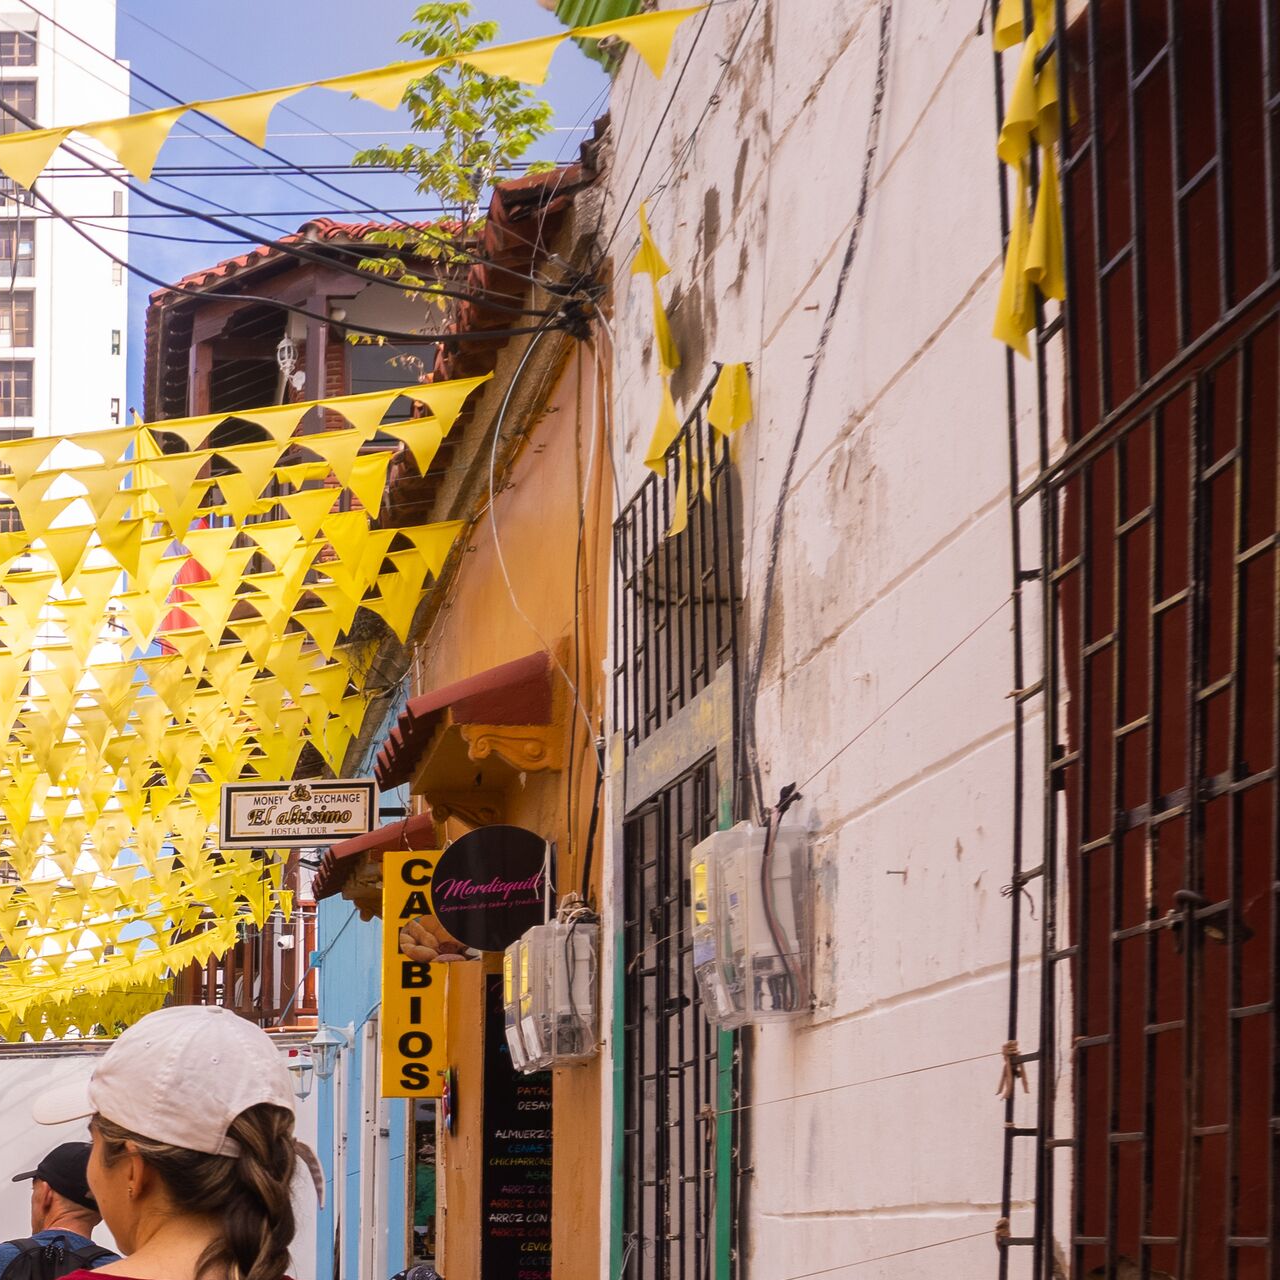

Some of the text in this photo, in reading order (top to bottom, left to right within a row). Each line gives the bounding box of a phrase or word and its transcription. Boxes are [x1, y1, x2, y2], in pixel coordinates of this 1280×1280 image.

[253, 793, 360, 806] MONEY EXCHANGE
[247, 804, 352, 826] El altisimo
[271, 826, 327, 835] HOSTAL TOUR
[398, 858, 433, 1090] CABIOS
[489, 1213, 548, 1223] ARROZ CON
